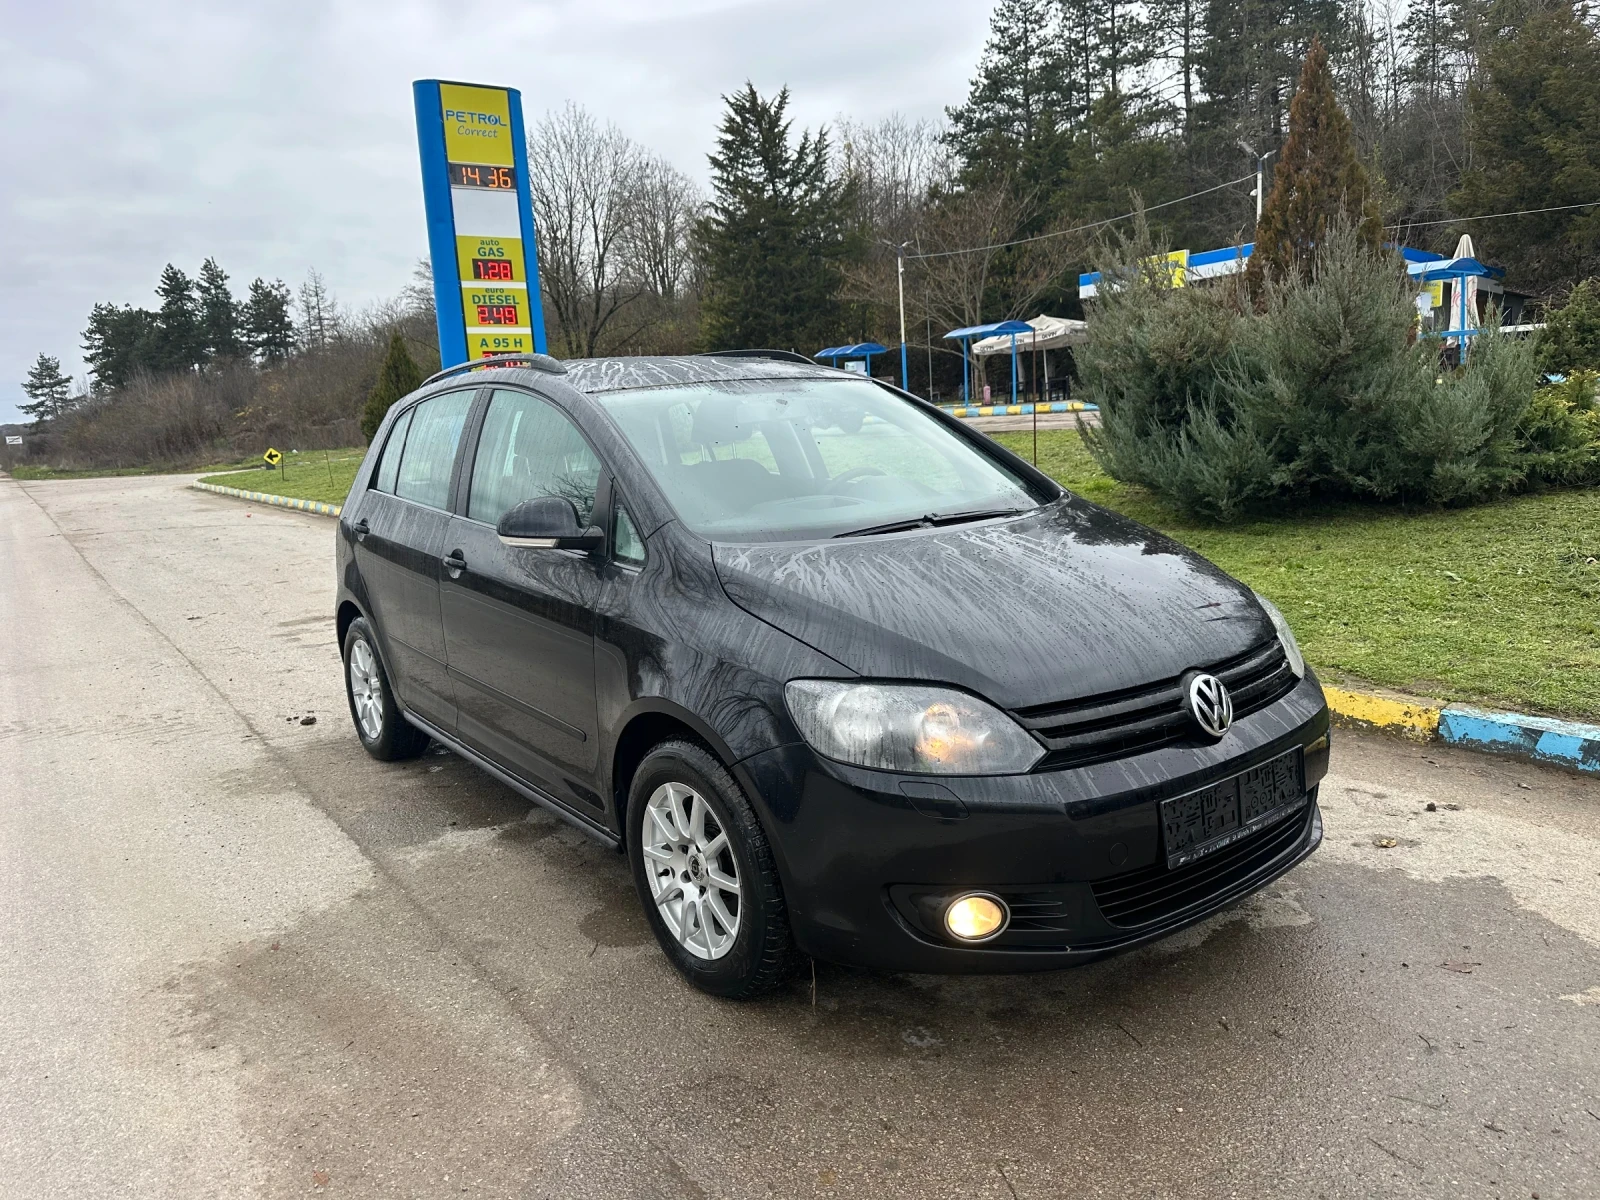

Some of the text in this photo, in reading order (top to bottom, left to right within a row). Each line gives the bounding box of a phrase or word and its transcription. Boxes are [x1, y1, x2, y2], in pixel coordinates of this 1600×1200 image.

[445, 110, 507, 127] PETROL
[457, 125, 498, 138] Correct
[477, 247, 505, 257] GAS
[477, 261, 511, 280] 1.28
[472, 294, 520, 305] DIESEL
[477, 307, 517, 325] 2.49
[480, 338, 523, 348] A 95 H
[1190, 674, 1232, 736] VW
